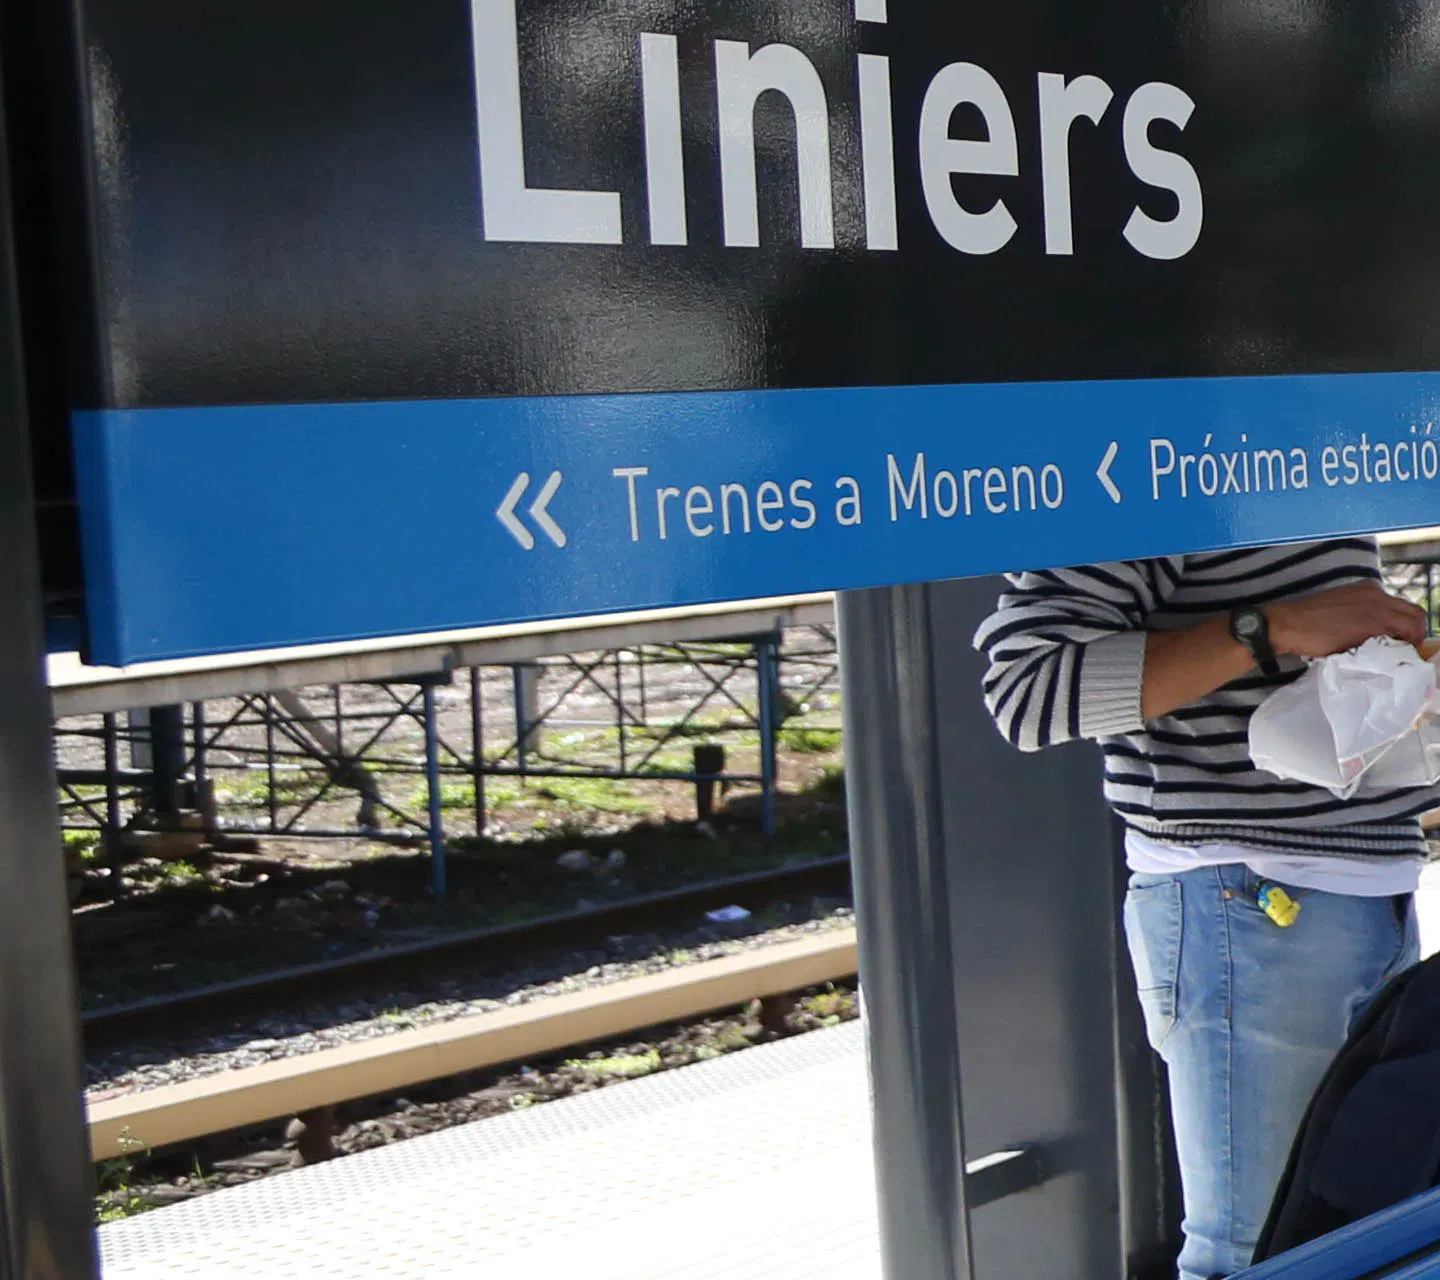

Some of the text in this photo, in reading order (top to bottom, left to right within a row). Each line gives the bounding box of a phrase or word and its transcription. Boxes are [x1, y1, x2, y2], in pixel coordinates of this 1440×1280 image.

[612, 452, 1063, 542] Trenes a Moreno
[1150, 431, 1309, 500] Próxima
